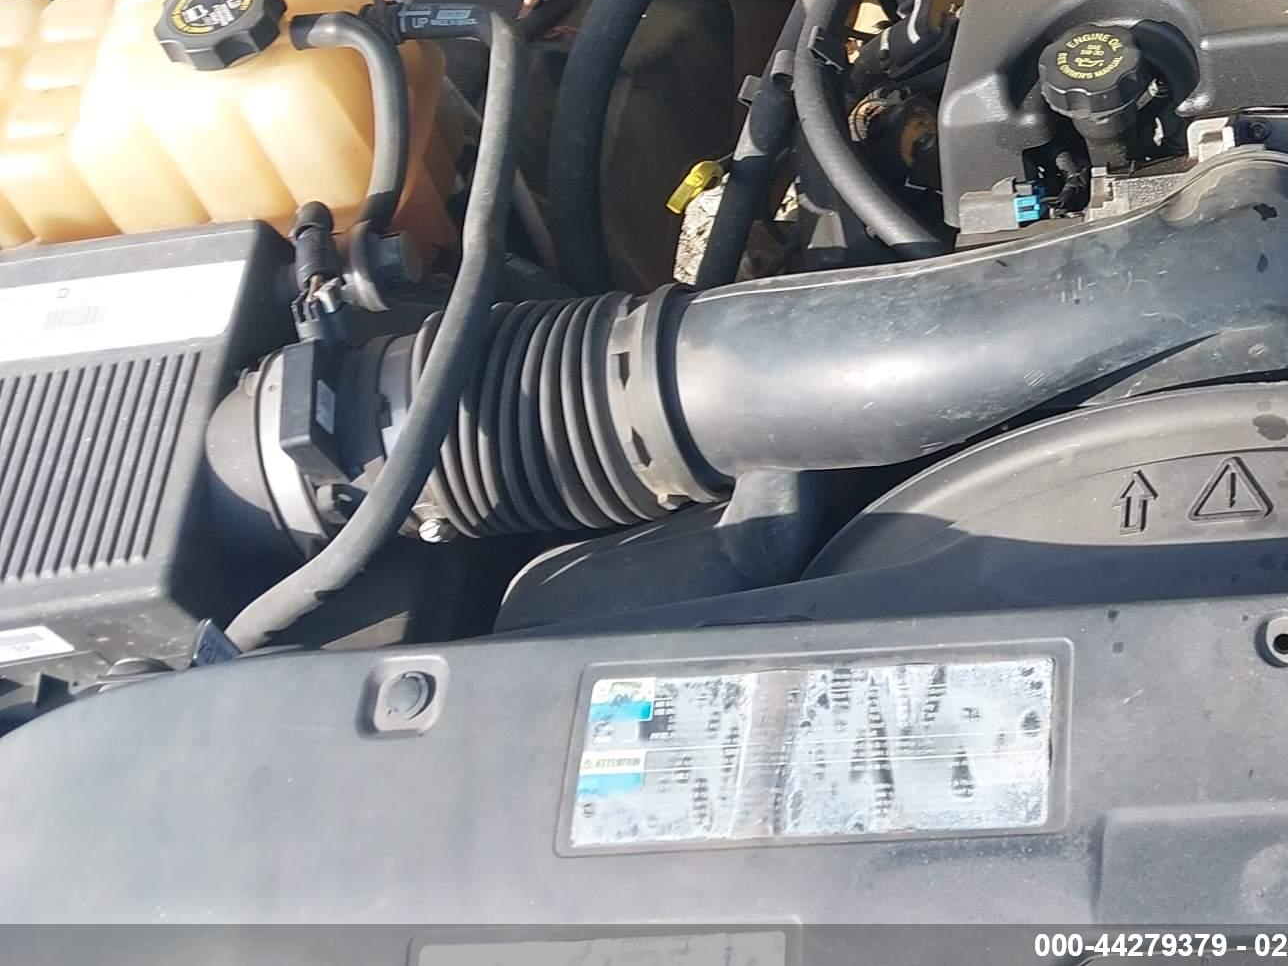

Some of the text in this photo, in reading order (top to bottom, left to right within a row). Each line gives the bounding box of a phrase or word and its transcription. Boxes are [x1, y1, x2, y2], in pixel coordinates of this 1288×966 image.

[1065, 33, 1123, 51] ENGINE OIL
[1094, 55, 1124, 77] MANUAL
